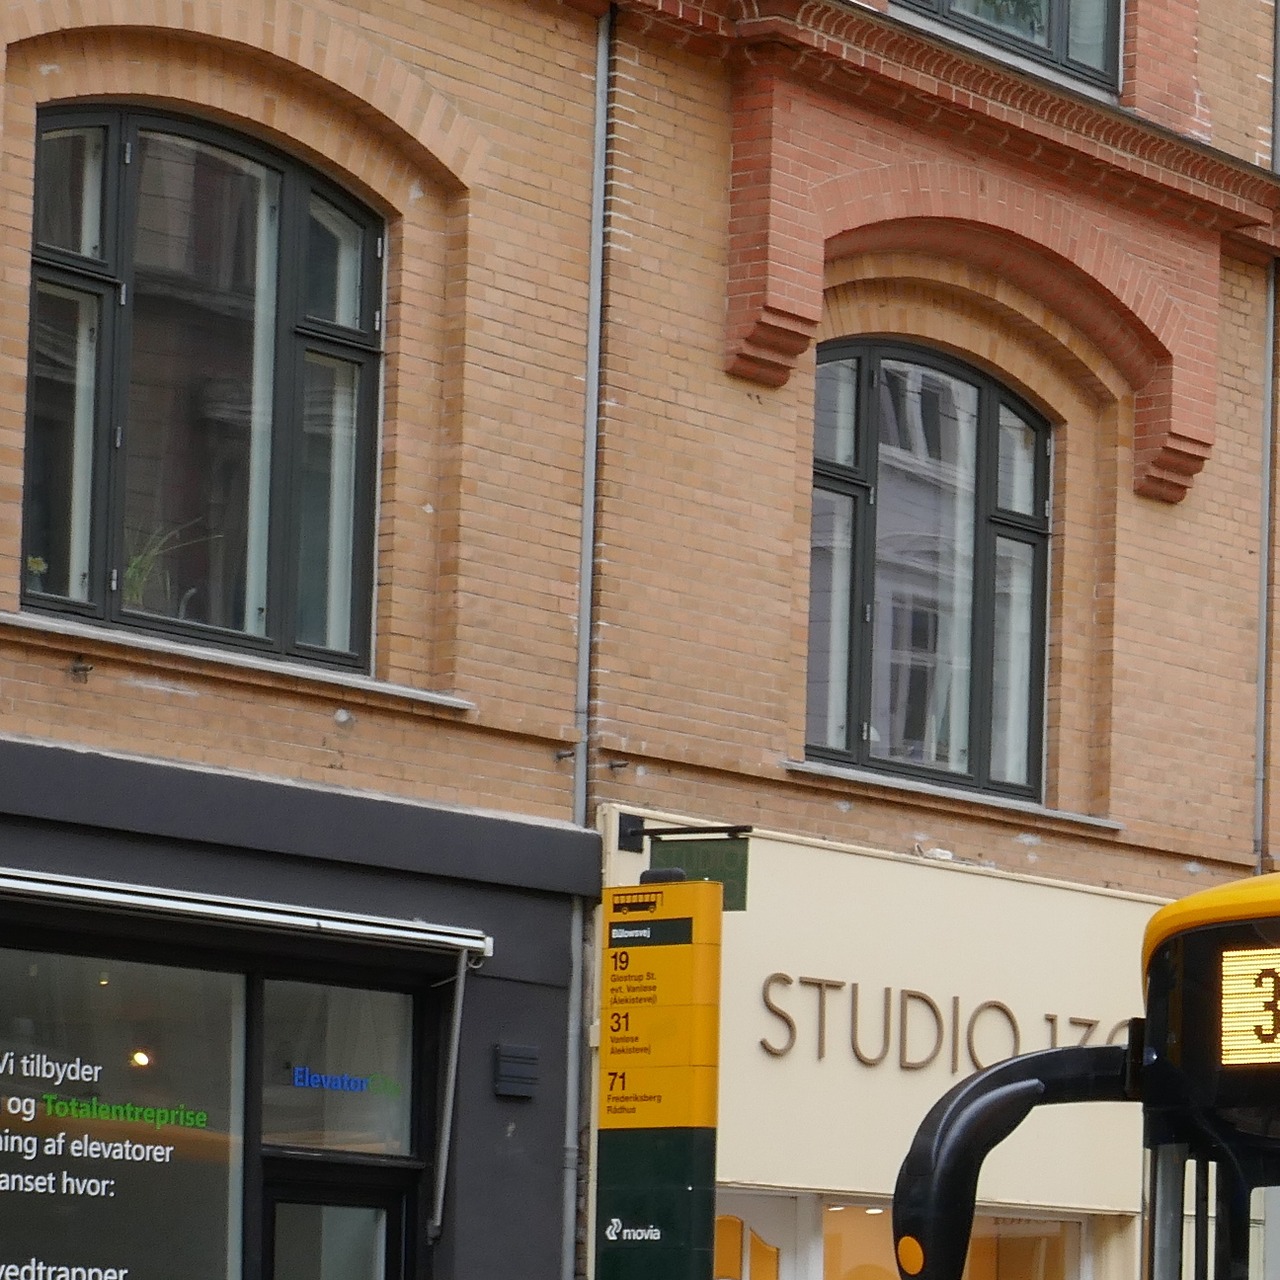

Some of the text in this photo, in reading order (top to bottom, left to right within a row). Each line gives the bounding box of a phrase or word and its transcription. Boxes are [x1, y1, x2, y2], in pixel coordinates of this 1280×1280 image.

[610, 951, 630, 971] 19
[610, 971, 657, 983] Glostrup St.
[610, 1012, 629, 1032] 31
[759, 972, 1021, 1075] STUDIO
[20, 1054, 103, 1086] tilbyder
[608, 1071, 626, 1091] 71
[607, 1093, 662, 1103] Frederiksberg
[7, 1093, 208, 1129] og Totalentreprise
[43, 1132, 66, 1155] af
[70, 1134, 174, 1162] elevatorer
[61, 1170, 116, 1197] hvor:
[622, 1225, 661, 1240] movia
